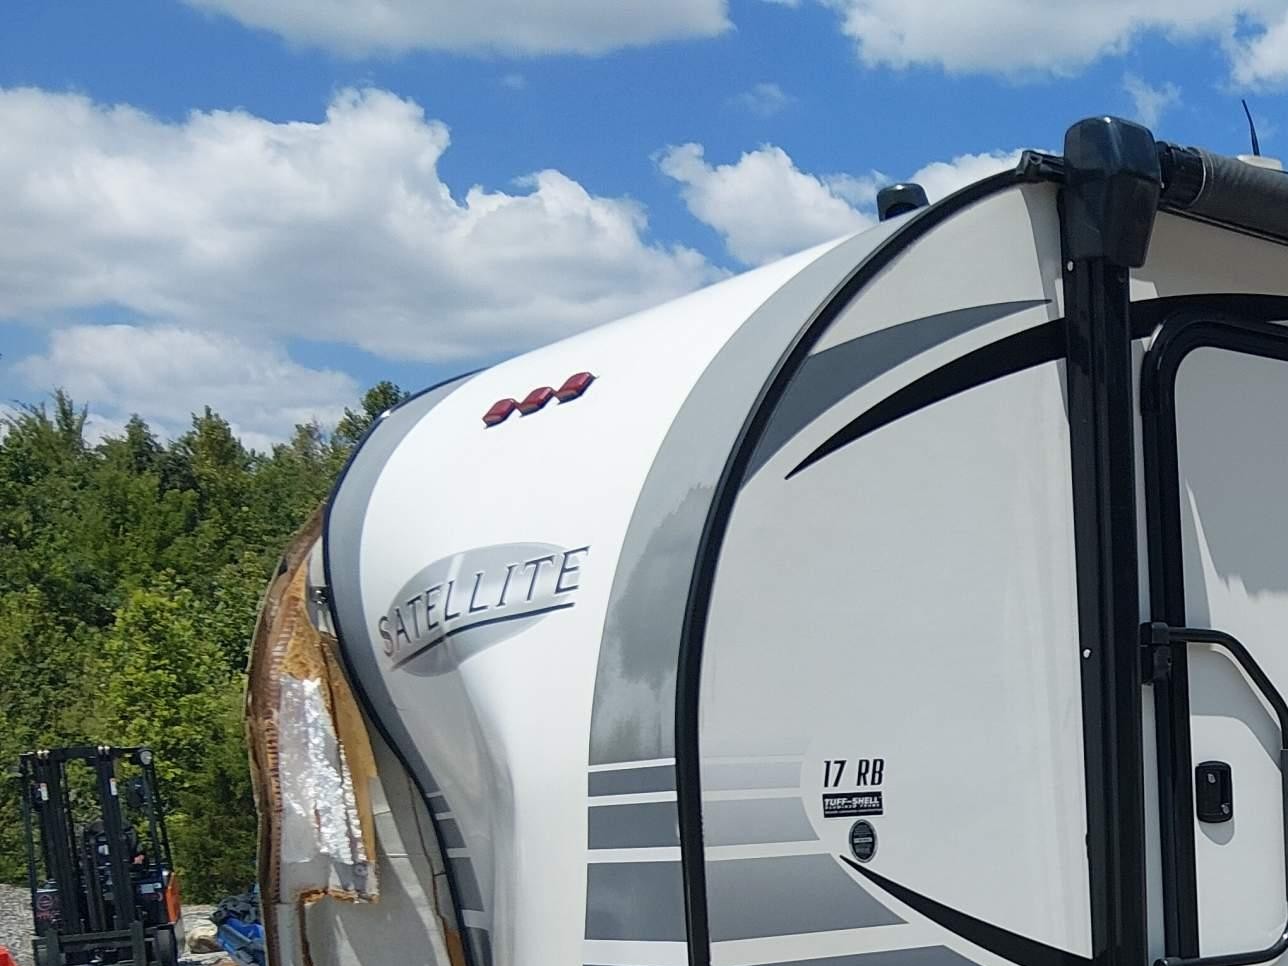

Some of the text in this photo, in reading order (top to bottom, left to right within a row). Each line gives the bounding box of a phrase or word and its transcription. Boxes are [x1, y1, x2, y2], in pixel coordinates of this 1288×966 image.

[378, 545, 591, 657] SATELLITE
[823, 758, 885, 788] 17 RB
